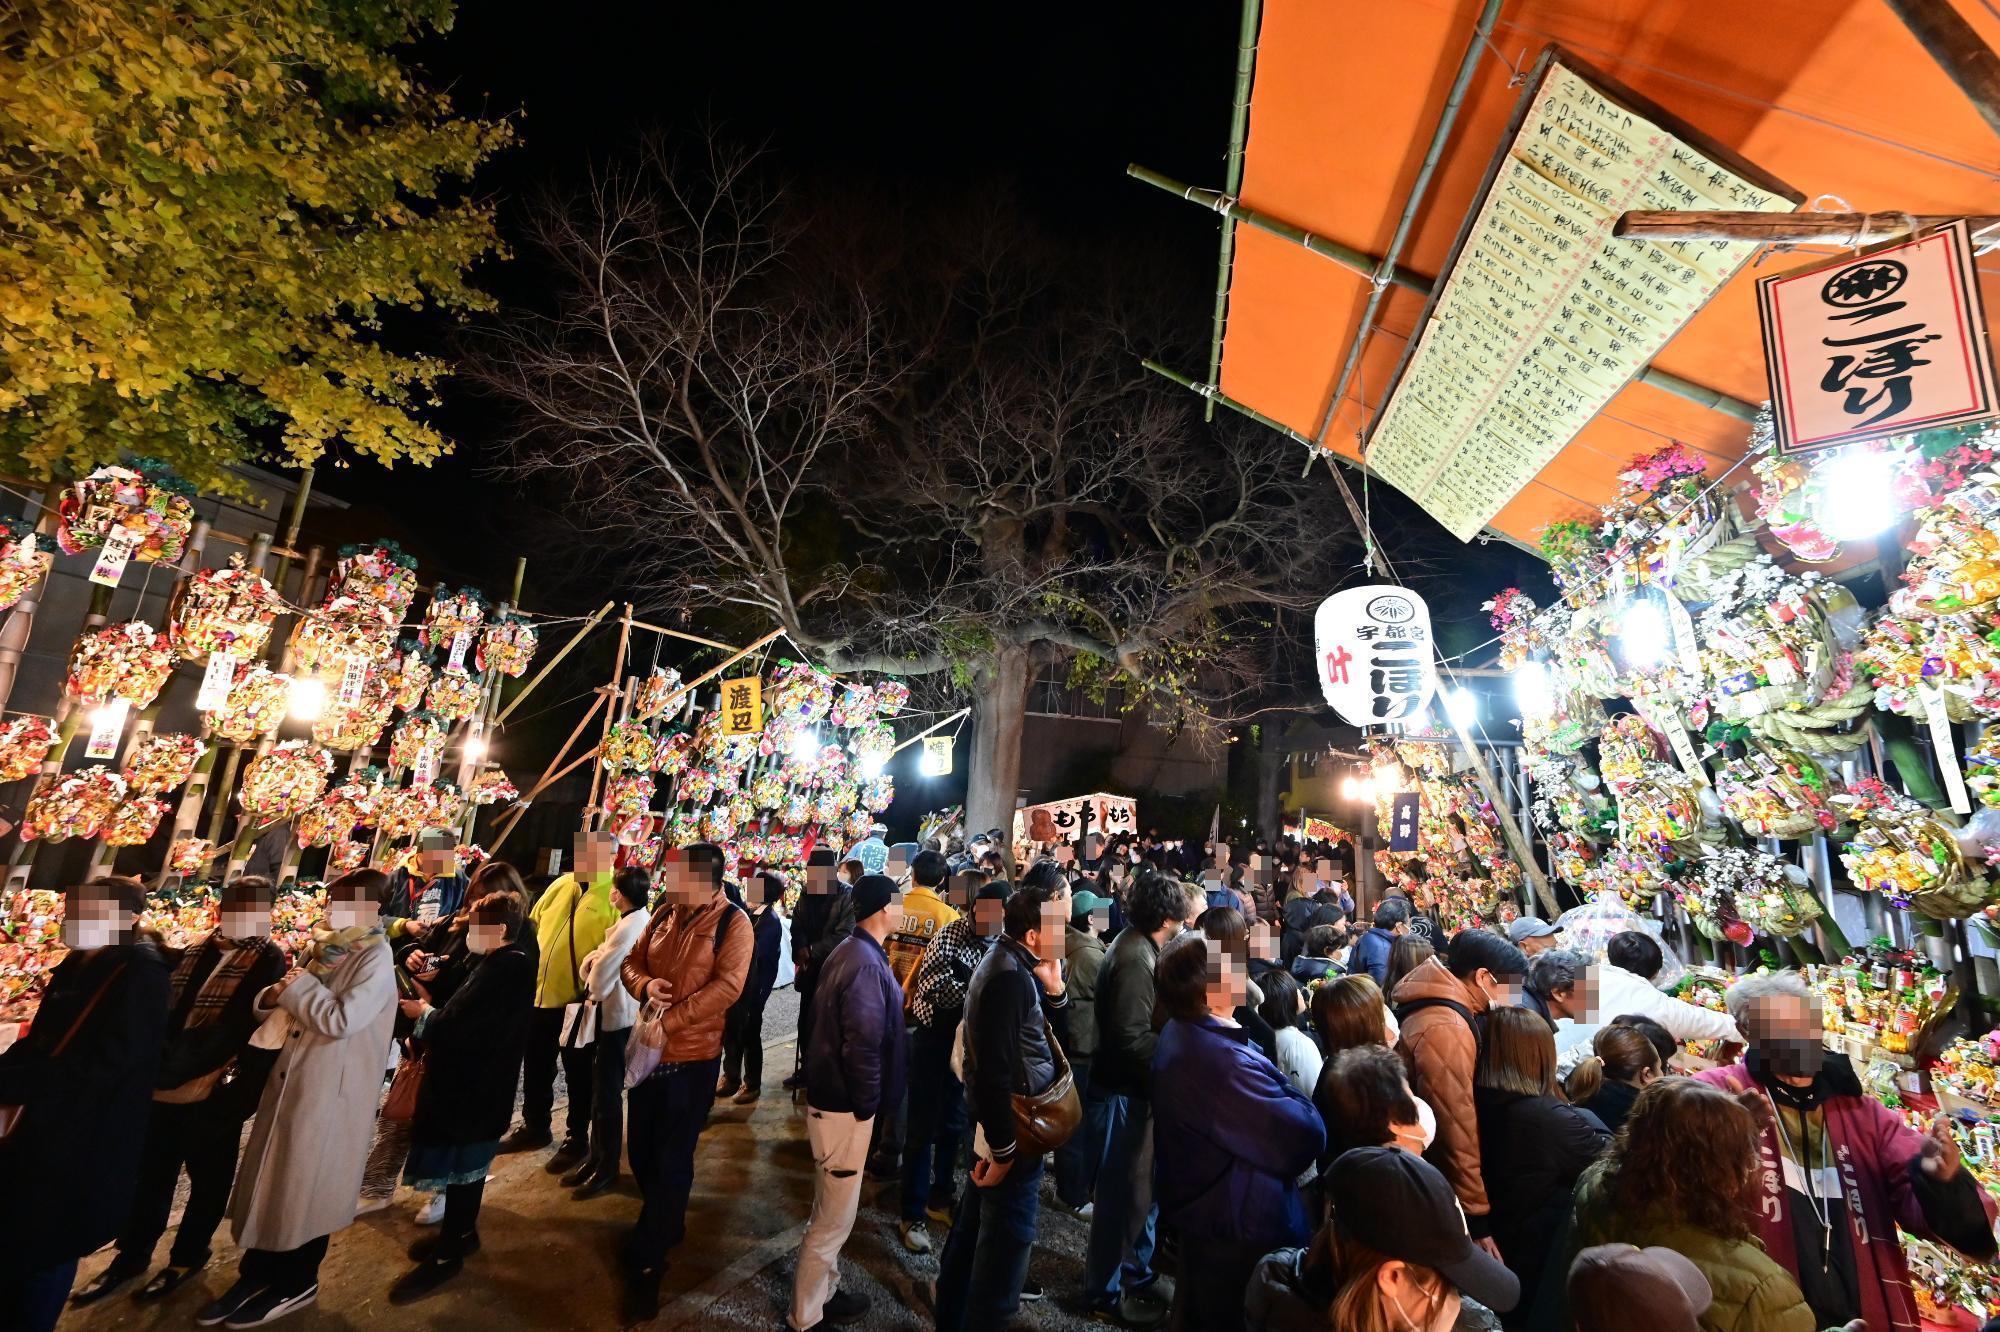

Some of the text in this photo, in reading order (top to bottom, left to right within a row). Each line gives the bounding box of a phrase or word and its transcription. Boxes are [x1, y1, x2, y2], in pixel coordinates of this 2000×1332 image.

[1820, 301, 1942, 429] 二ぼり
[1357, 625, 1424, 640] 宇都宮
[1327, 645, 1352, 684] 叶
[730, 684, 753, 731] 渡辺
[1109, 804, 1129, 823] もち
